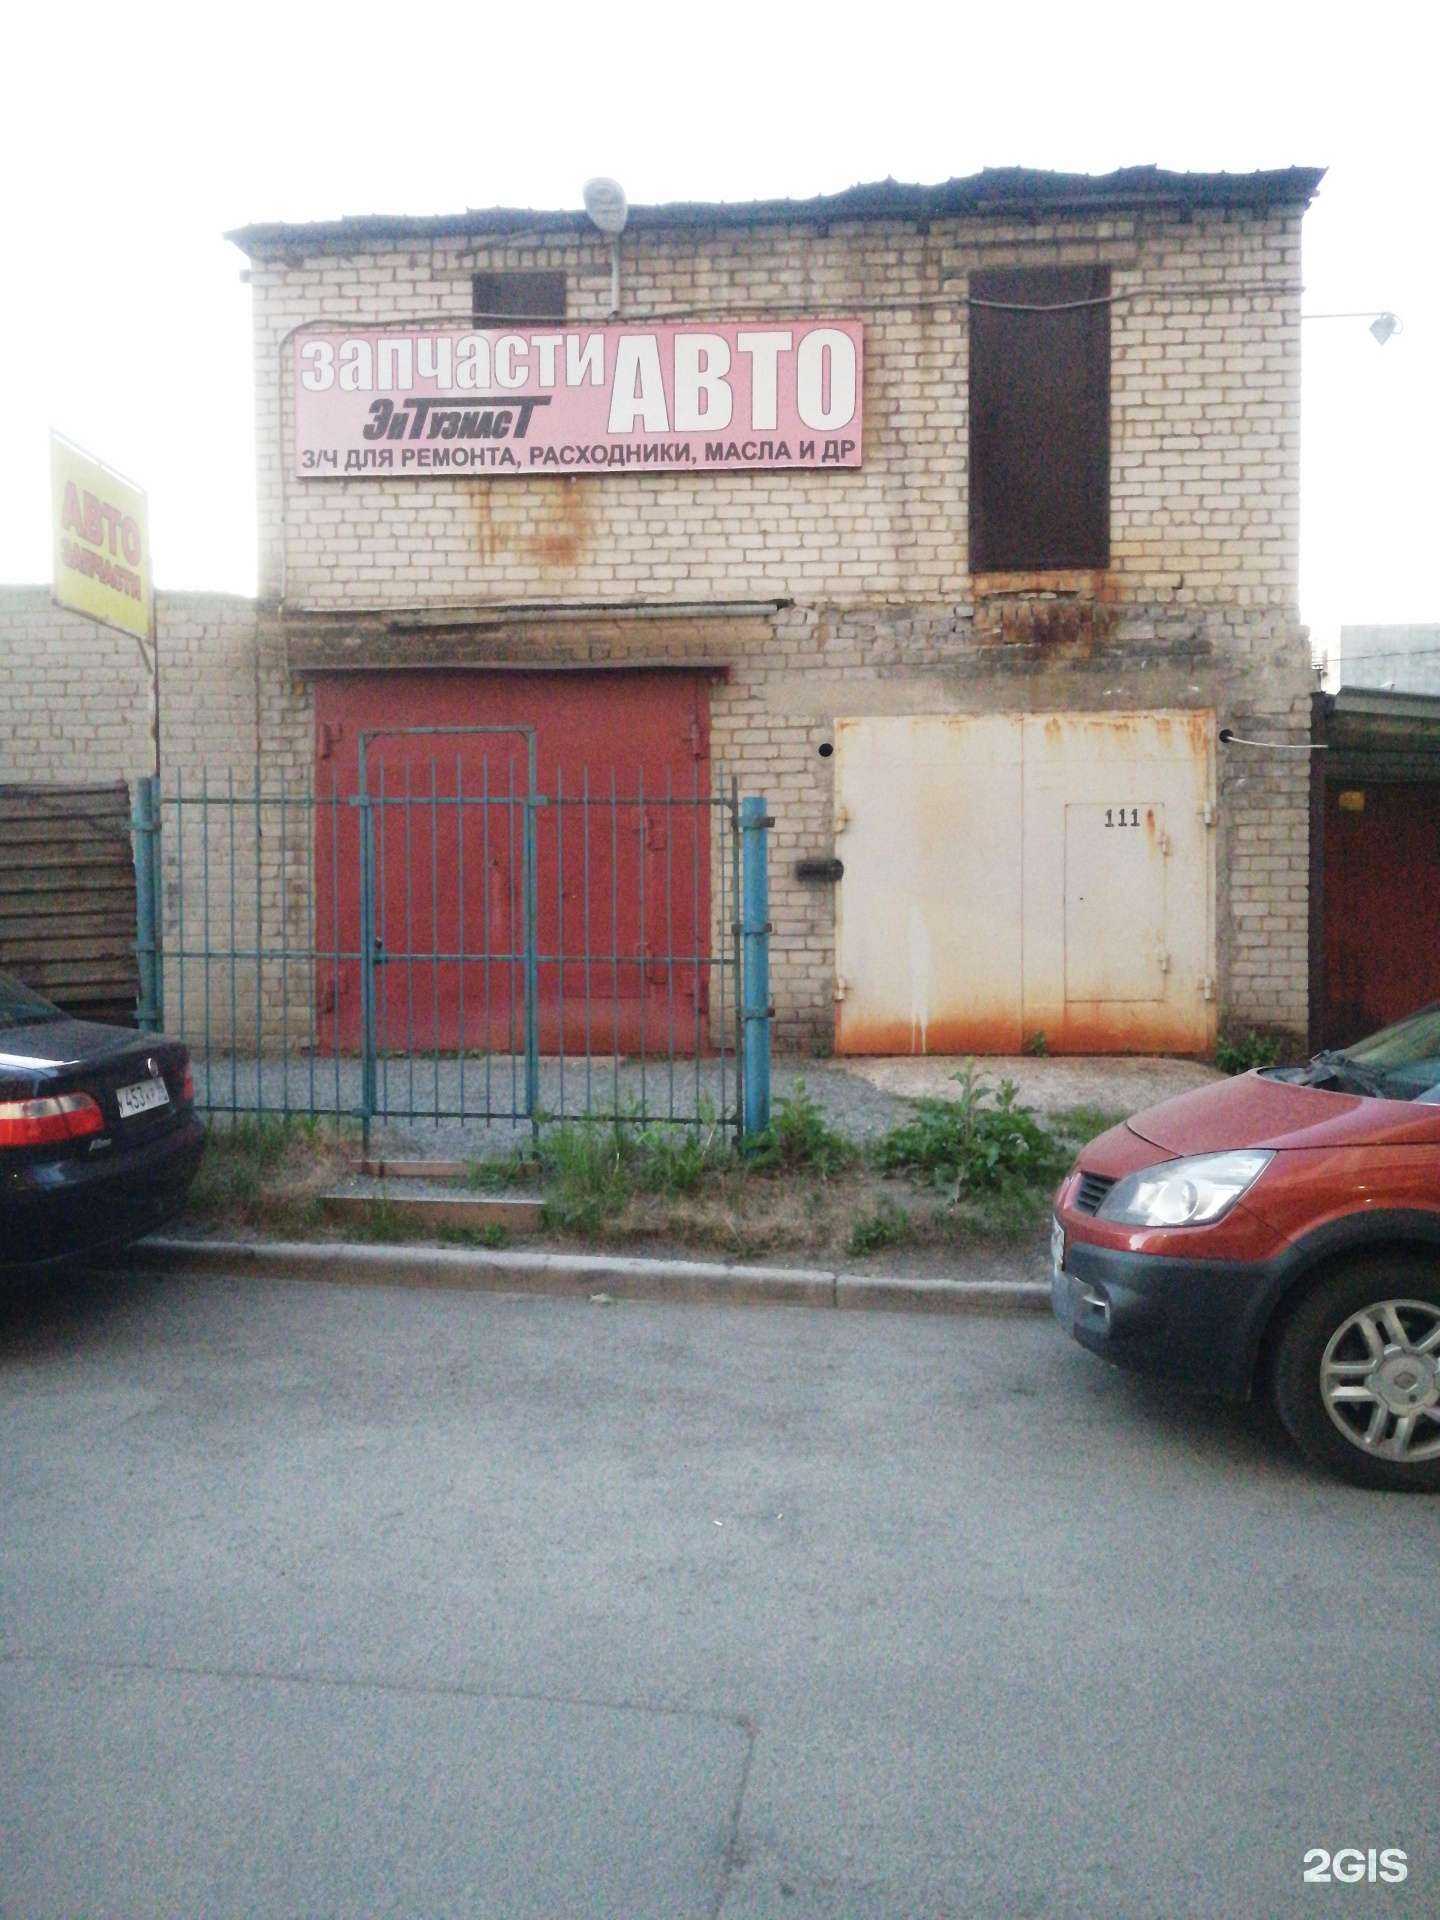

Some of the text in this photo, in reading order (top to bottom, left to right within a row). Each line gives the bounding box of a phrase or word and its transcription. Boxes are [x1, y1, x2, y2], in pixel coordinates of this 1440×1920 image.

[607, 328, 857, 433] АВТО
[302, 439, 856, 471] З/Ч ДЛЯ РЕМОНТА, РАСХОДНИКИ, МАСЛА И ДР
[61, 480, 141, 567] АВТО
[61, 538, 142, 602] ЗАПЧАСТИ
[1104, 808, 1141, 828] 111
